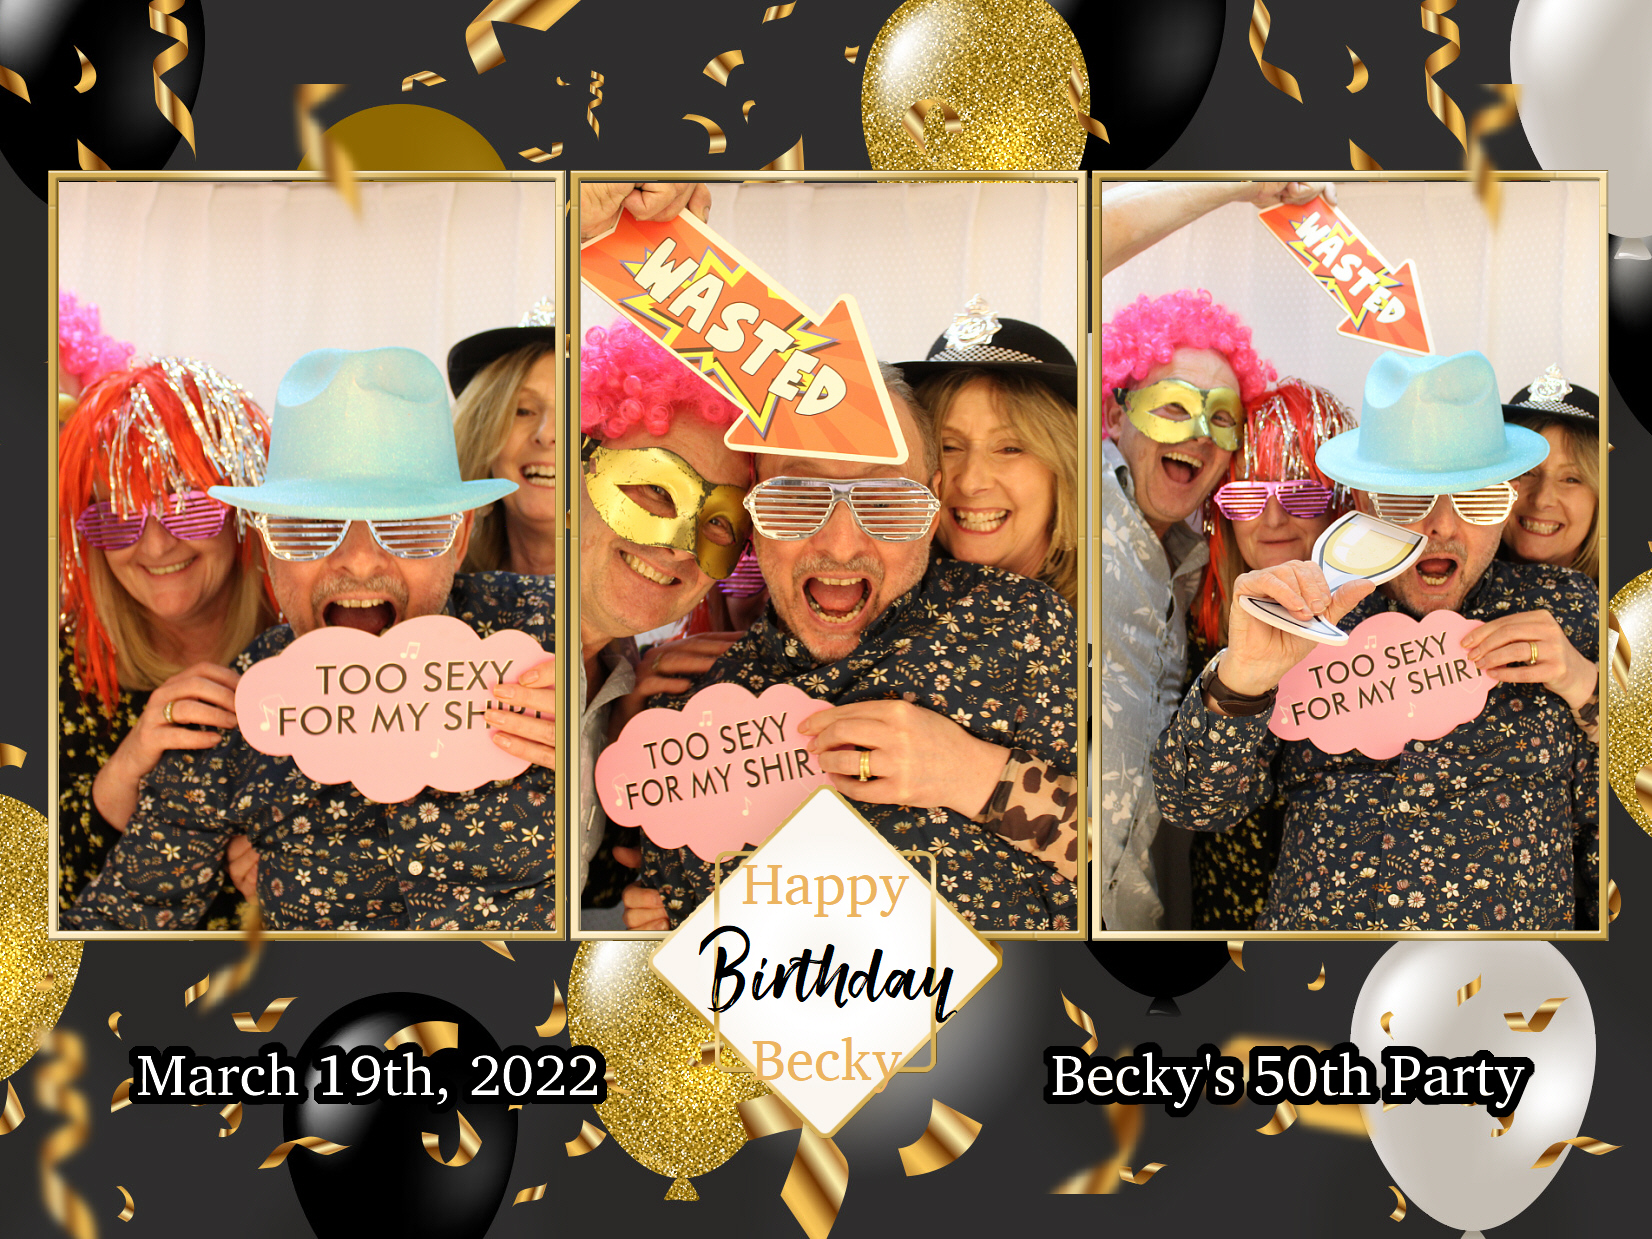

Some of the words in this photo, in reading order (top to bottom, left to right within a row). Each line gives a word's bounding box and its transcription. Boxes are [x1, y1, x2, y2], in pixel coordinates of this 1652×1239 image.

[1295, 211, 1406, 324] WASTED
[633, 237, 847, 416] WASTED
[315, 663, 407, 695] TOO
[423, 660, 514, 692] SEXY
[1308, 653, 1375, 689] TOO
[1384, 631, 1447, 669] SEXY
[278, 704, 357, 736] FOR
[371, 702, 430, 733] MY
[1290, 691, 1350, 726] FOR
[1358, 677, 1396, 709] MY
[643, 732, 709, 769] TOO
[719, 712, 787, 754] SEXY
[625, 775, 684, 810] FOR
[692, 763, 733, 798] MY
[743, 748, 826, 788] SHIR
